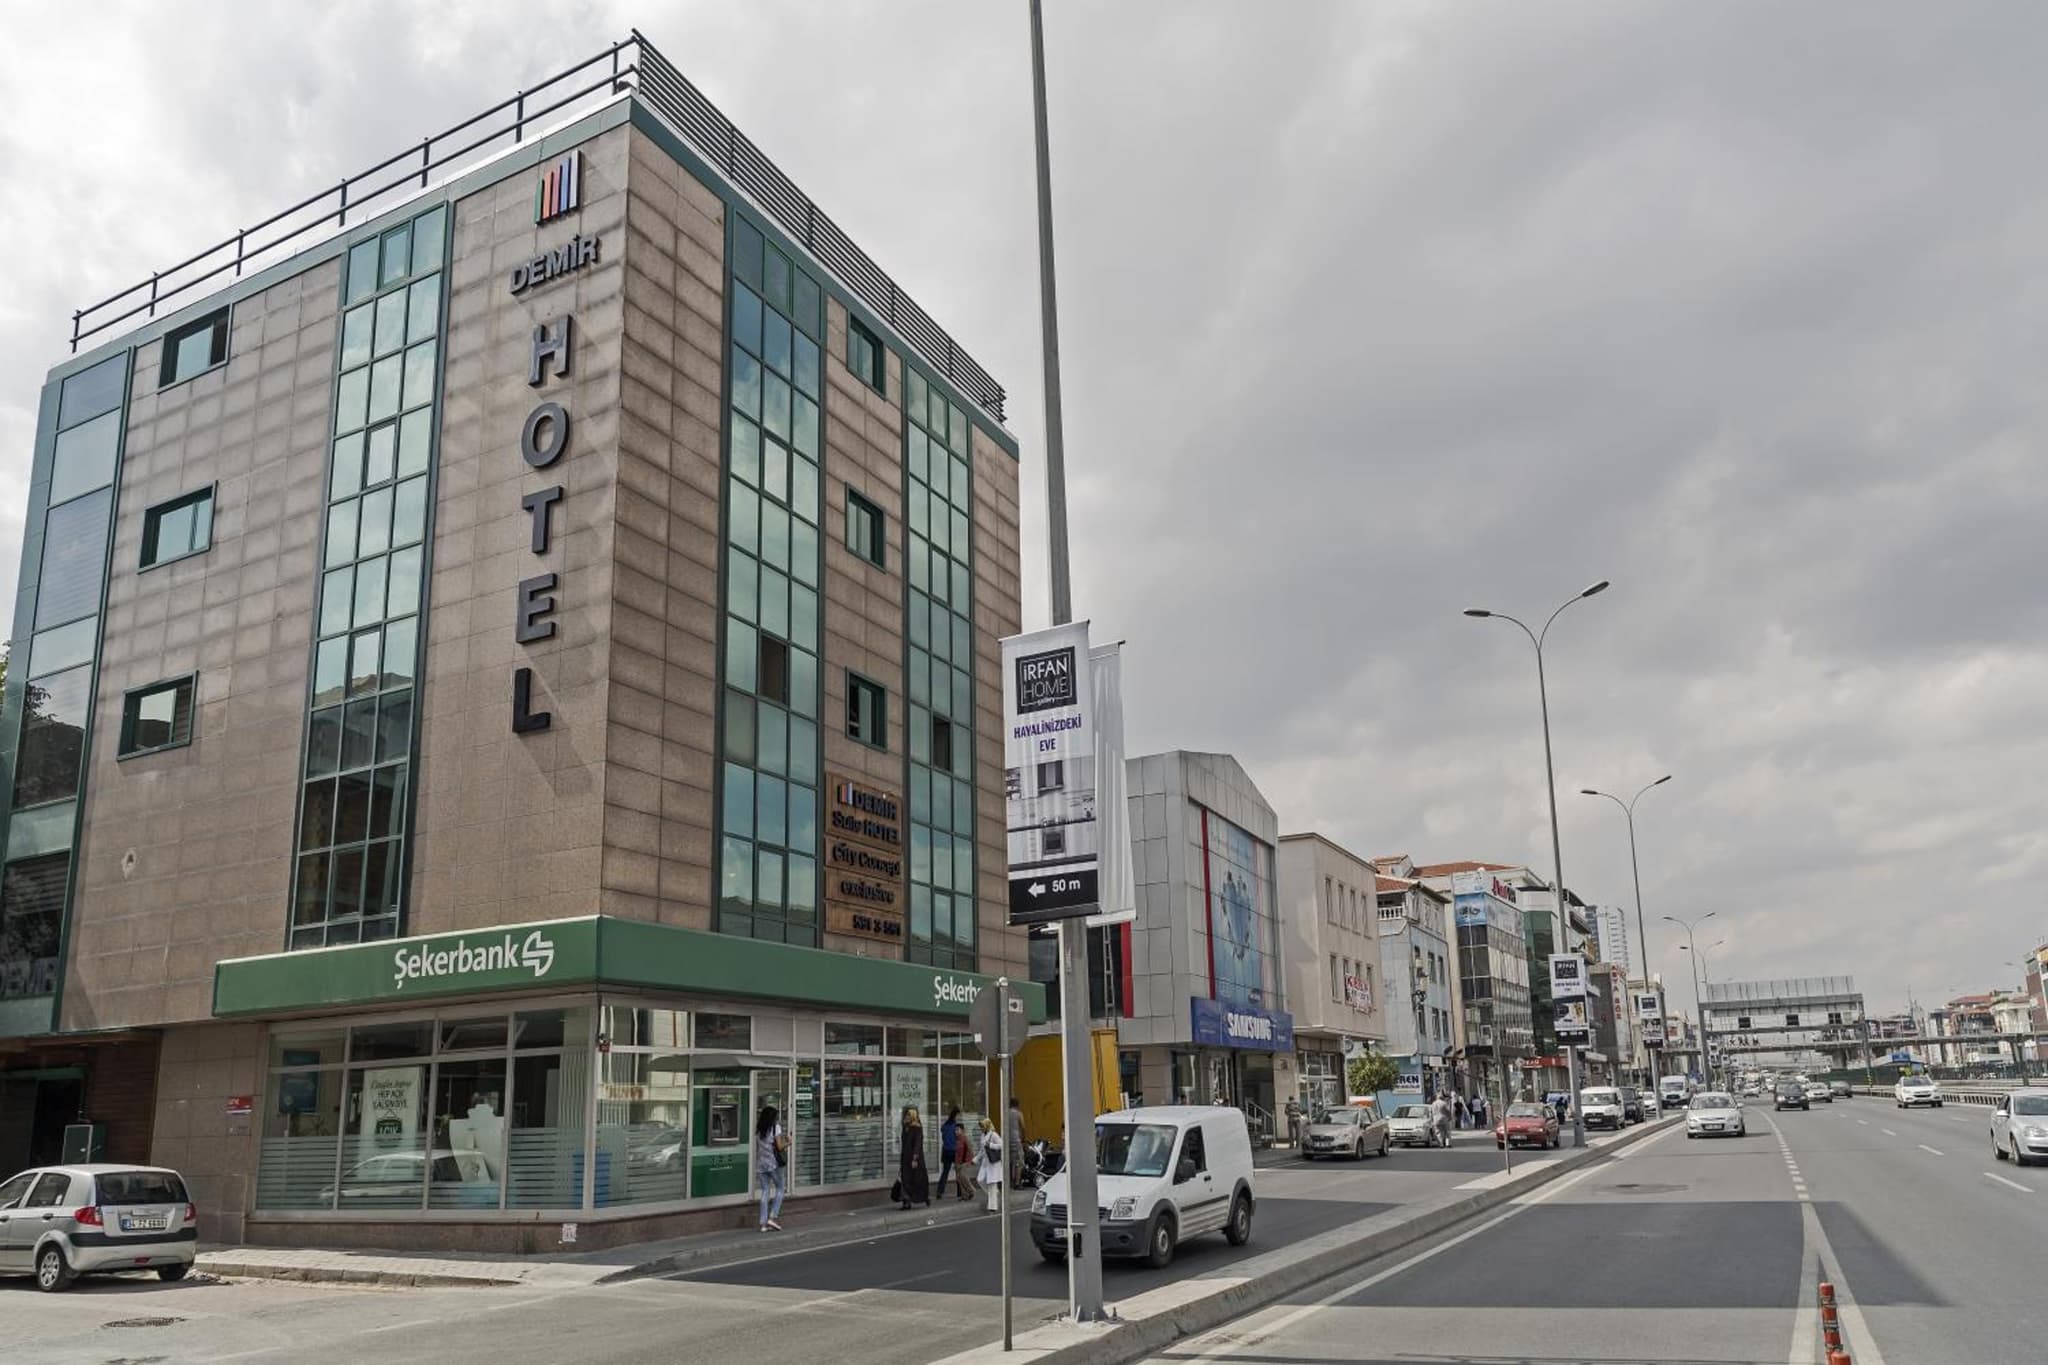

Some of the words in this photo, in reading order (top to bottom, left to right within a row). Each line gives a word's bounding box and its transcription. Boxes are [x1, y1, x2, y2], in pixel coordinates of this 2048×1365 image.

[509, 233, 599, 295] DEMİR
[512, 313, 572, 734] HOTEL
[1023, 676, 1069, 700] HOME
[1013, 713, 1083, 739] HAYALİNİZDEKİ
[1040, 738, 1057, 752] EVE
[1052, 878, 1066, 893] 50
[1069, 879, 1081, 891] m
[394, 934, 519, 989] Şekerbank
[1227, 1012, 1272, 1041] SAMSUNG
